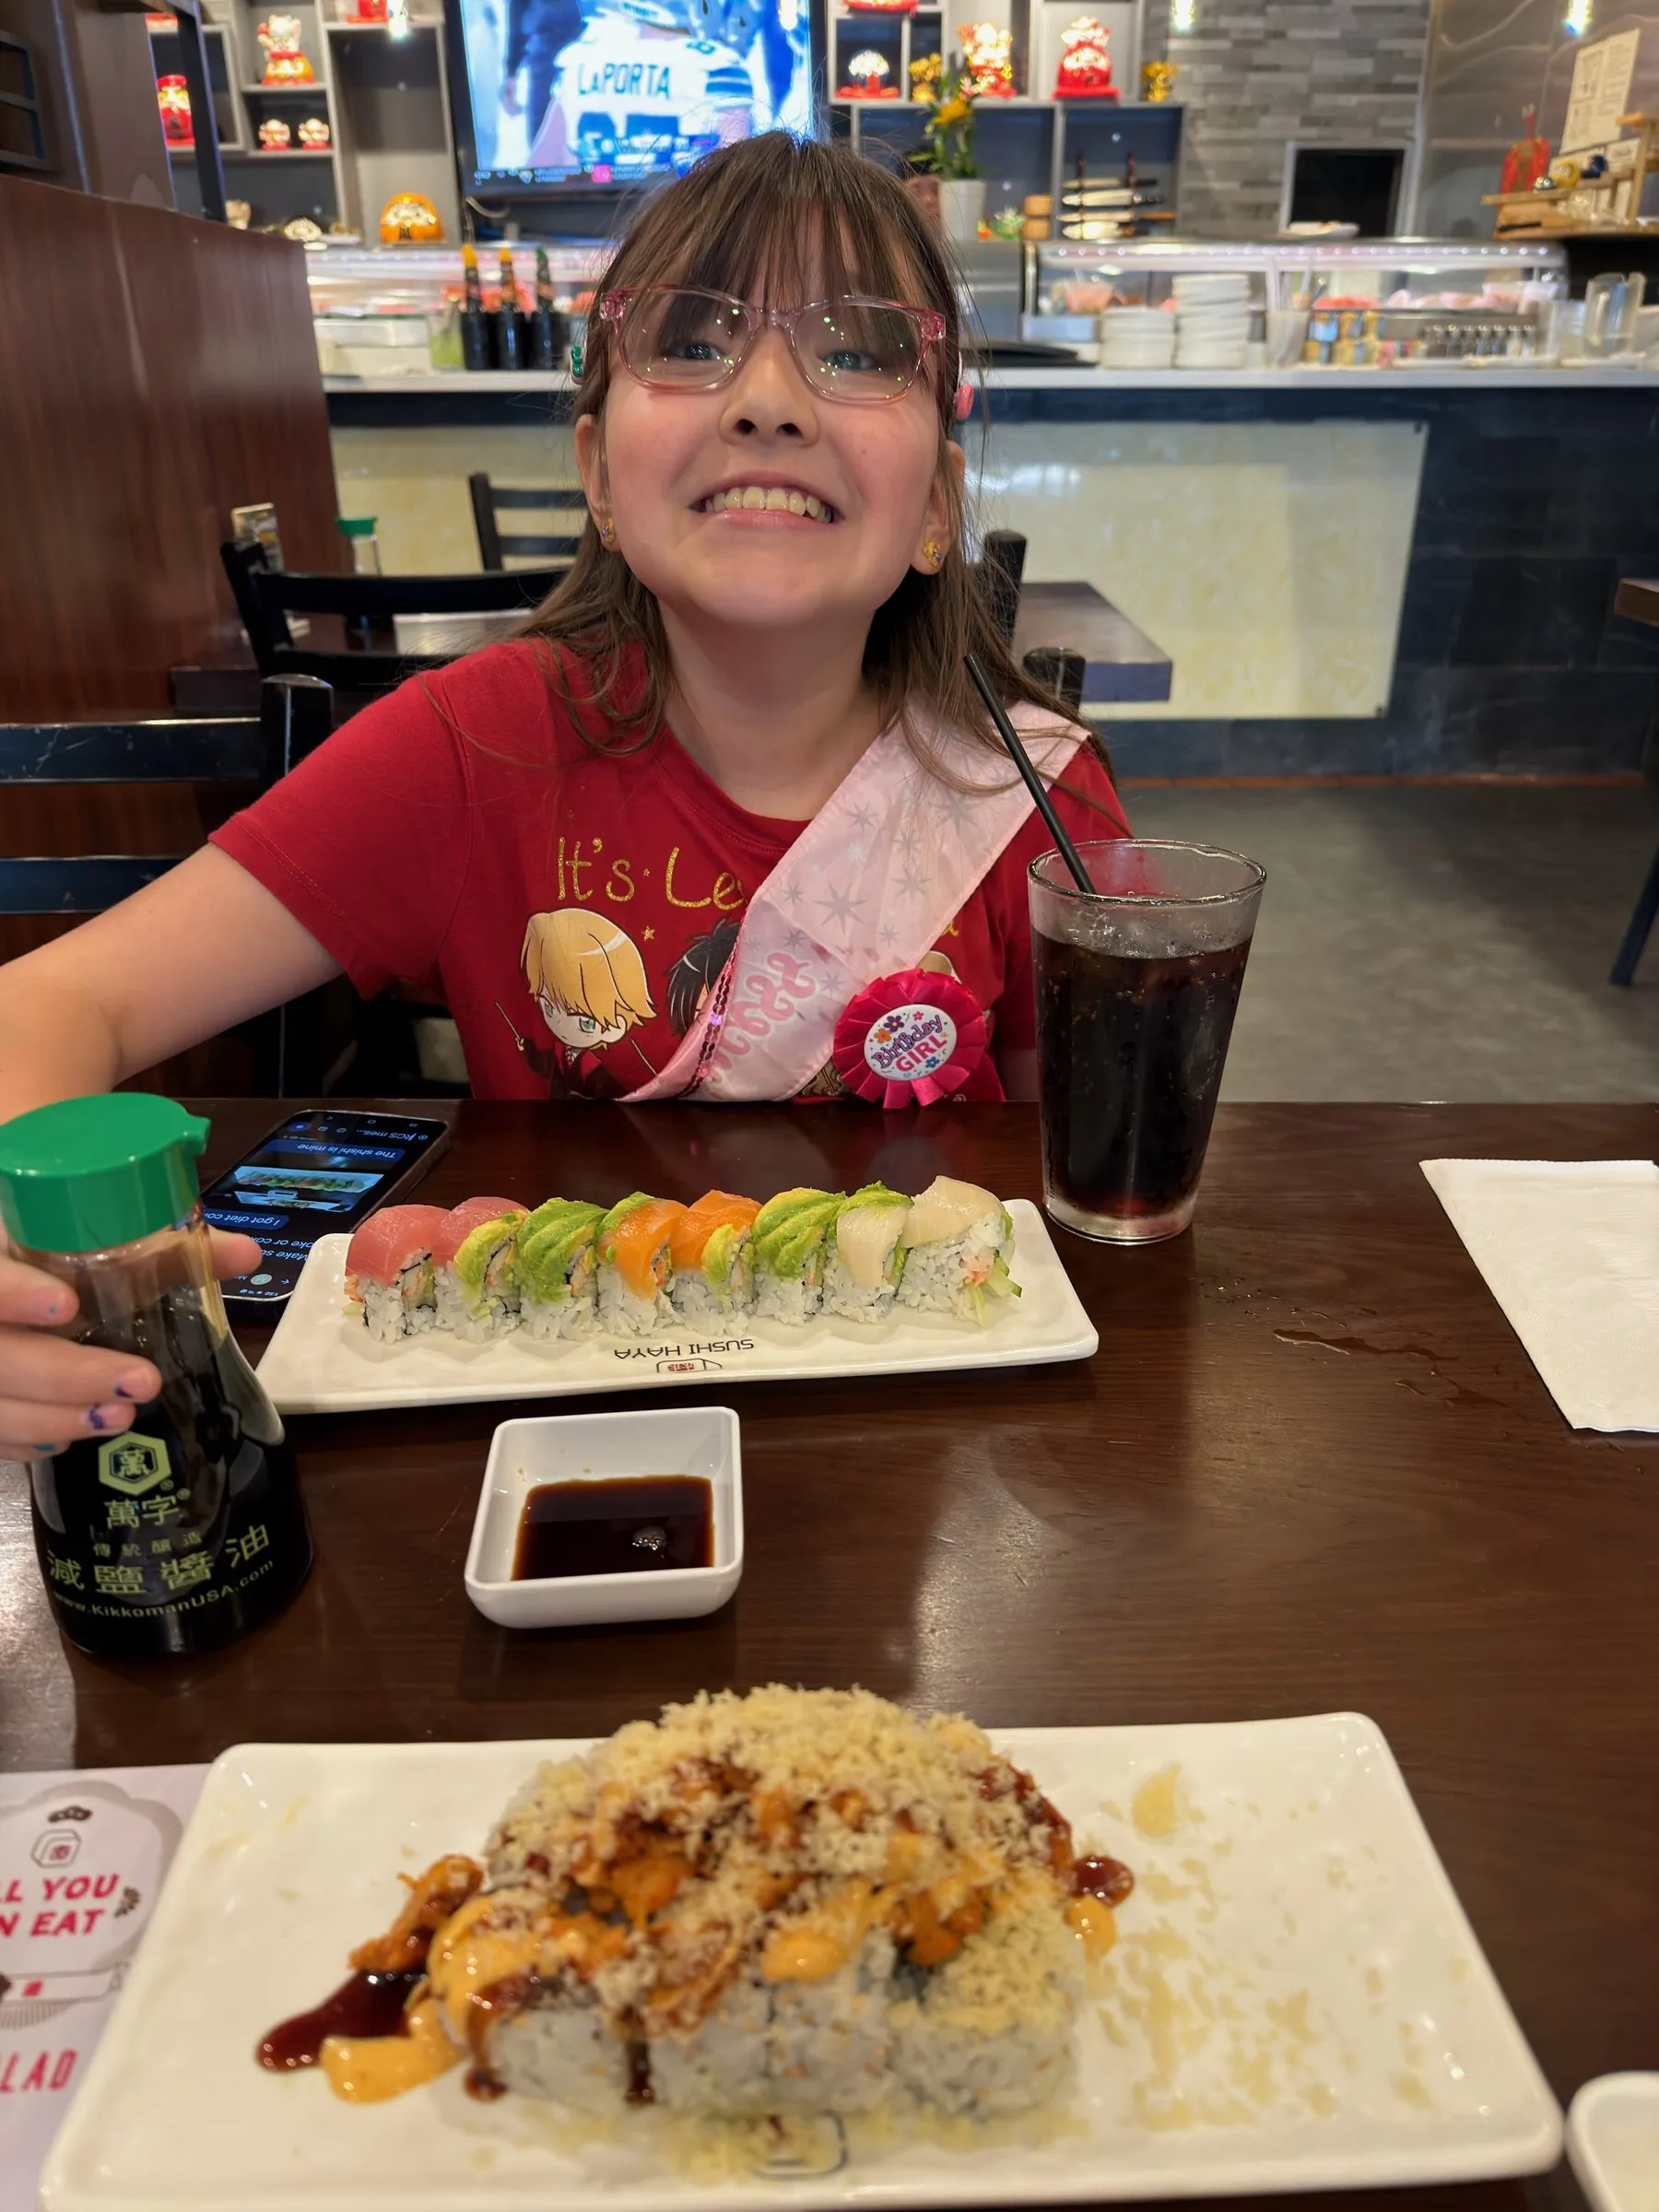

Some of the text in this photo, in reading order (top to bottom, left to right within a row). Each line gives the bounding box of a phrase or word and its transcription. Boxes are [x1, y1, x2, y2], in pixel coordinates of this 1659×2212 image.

[558, 836, 745, 911] It's Le
[871, 1014, 943, 1069] Birthday
[895, 1034, 947, 1072] GIRL
[297, 1144, 327, 1152] mine
[374, 1150, 396, 1159] The
[224, 1214, 250, 1223] diet
[251, 1217, 273, 1225] got
[273, 1238, 289, 1246] or
[290, 1240, 313, 1250] oke
[614, 1338, 754, 1359] SUSHI HAYA
[42, 1872, 119, 1901] YOU
[30, 1908, 106, 1937] EAT
[0, 2049, 78, 2093] LAD
